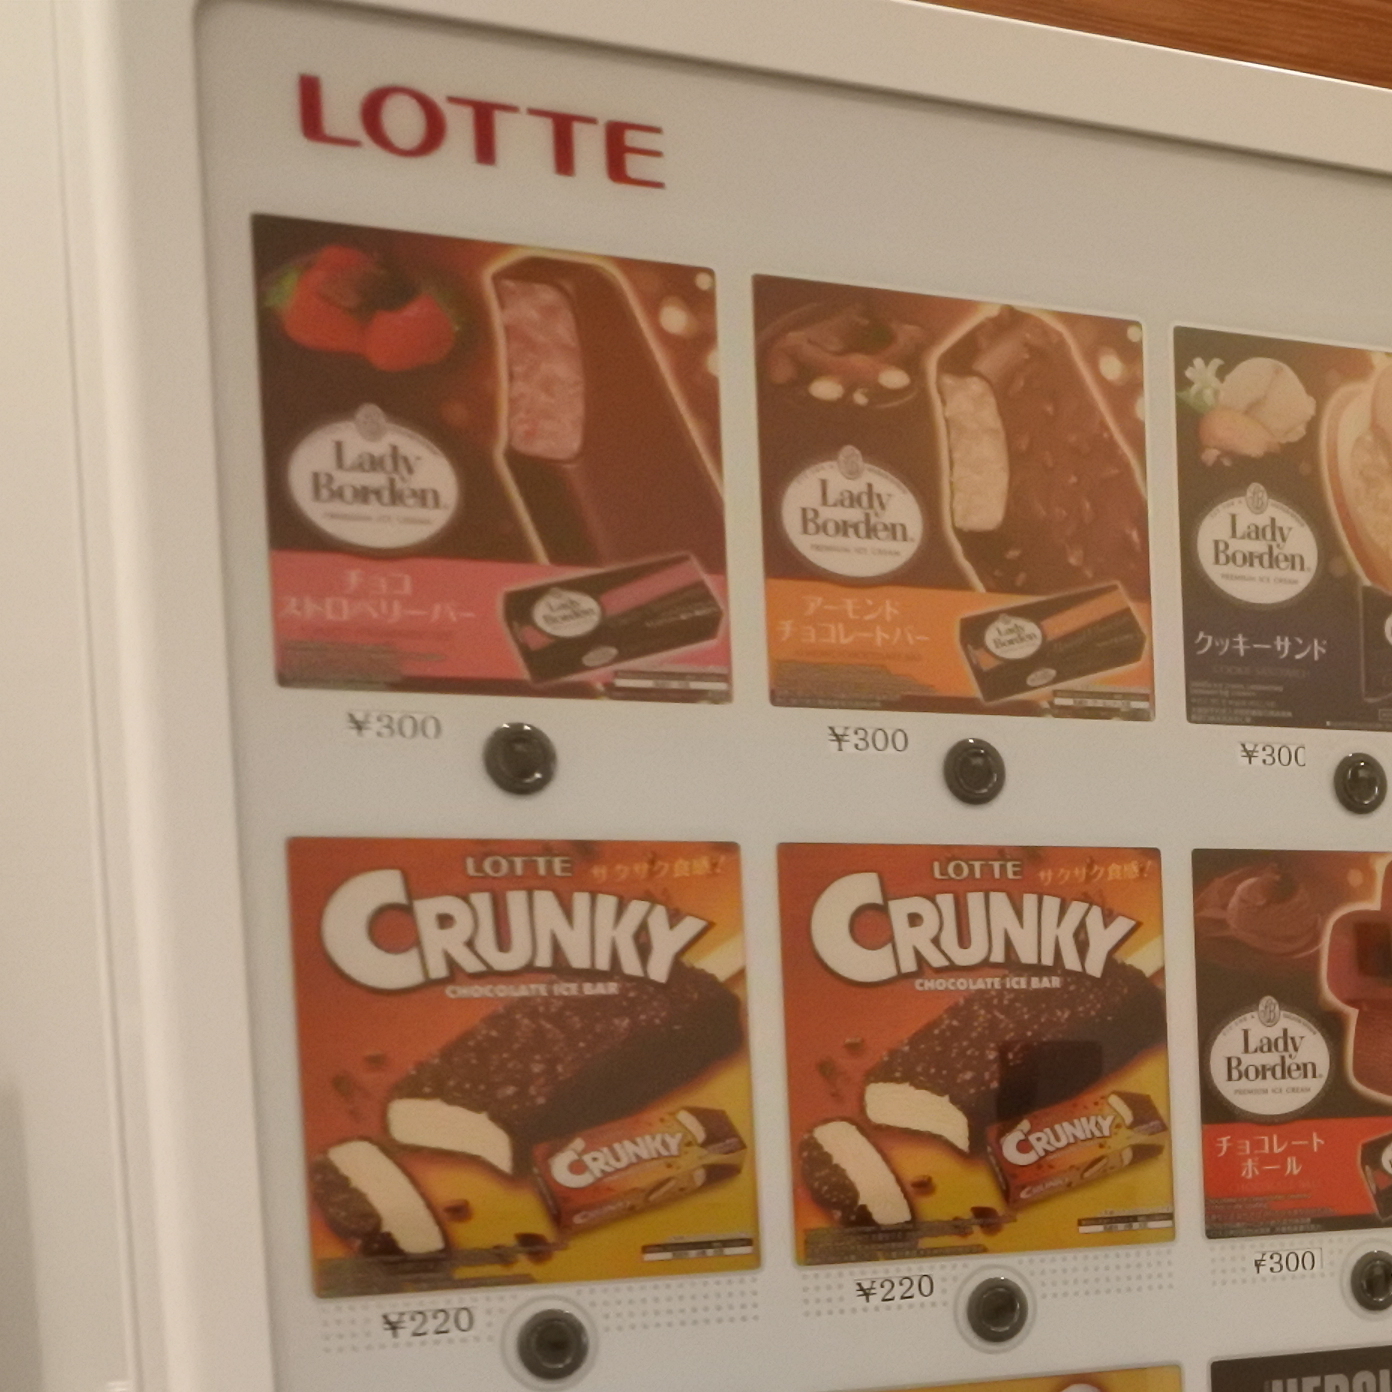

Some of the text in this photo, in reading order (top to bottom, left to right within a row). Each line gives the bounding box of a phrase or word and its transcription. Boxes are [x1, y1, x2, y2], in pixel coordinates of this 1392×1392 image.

[297, 73, 666, 190] LOTTE
[333, 440, 421, 486] Lady
[310, 470, 442, 511] Borden
[819, 478, 894, 518] Lady
[800, 506, 910, 544] Borden
[1228, 513, 1294, 552] Lady
[1212, 539, 1307, 574] Borden
[343, 568, 413, 596] チョコ
[802, 597, 900, 621] アーモンド
[776, 617, 930, 648] チョコレートバー
[1194, 631, 1327, 662] クッキーサンド
[345, 711, 444, 740] ¥300
[827, 725, 910, 753] ¥300
[465, 855, 574, 879] LOTTE
[933, 860, 1022, 881] LOTTE
[320, 868, 709, 991] CRUNKY
[810, 871, 1136, 983] CRUNKY
[445, 981, 620, 999] CHOCOLATE ICE BAR
[914, 976, 1062, 991] CHOCOLATE ICE BAR
[1241, 1028, 1305, 1060] Lady
[1225, 1055, 1319, 1082] Borden
[1001, 1113, 1114, 1166] CRUNKY
[1215, 1131, 1326, 1157] チョコレート
[548, 1131, 683, 1189] CRUNKY
[1240, 1156, 1303, 1179] ボール
[855, 1274, 936, 1305] ¥220
[381, 1306, 475, 1340] ¥220
